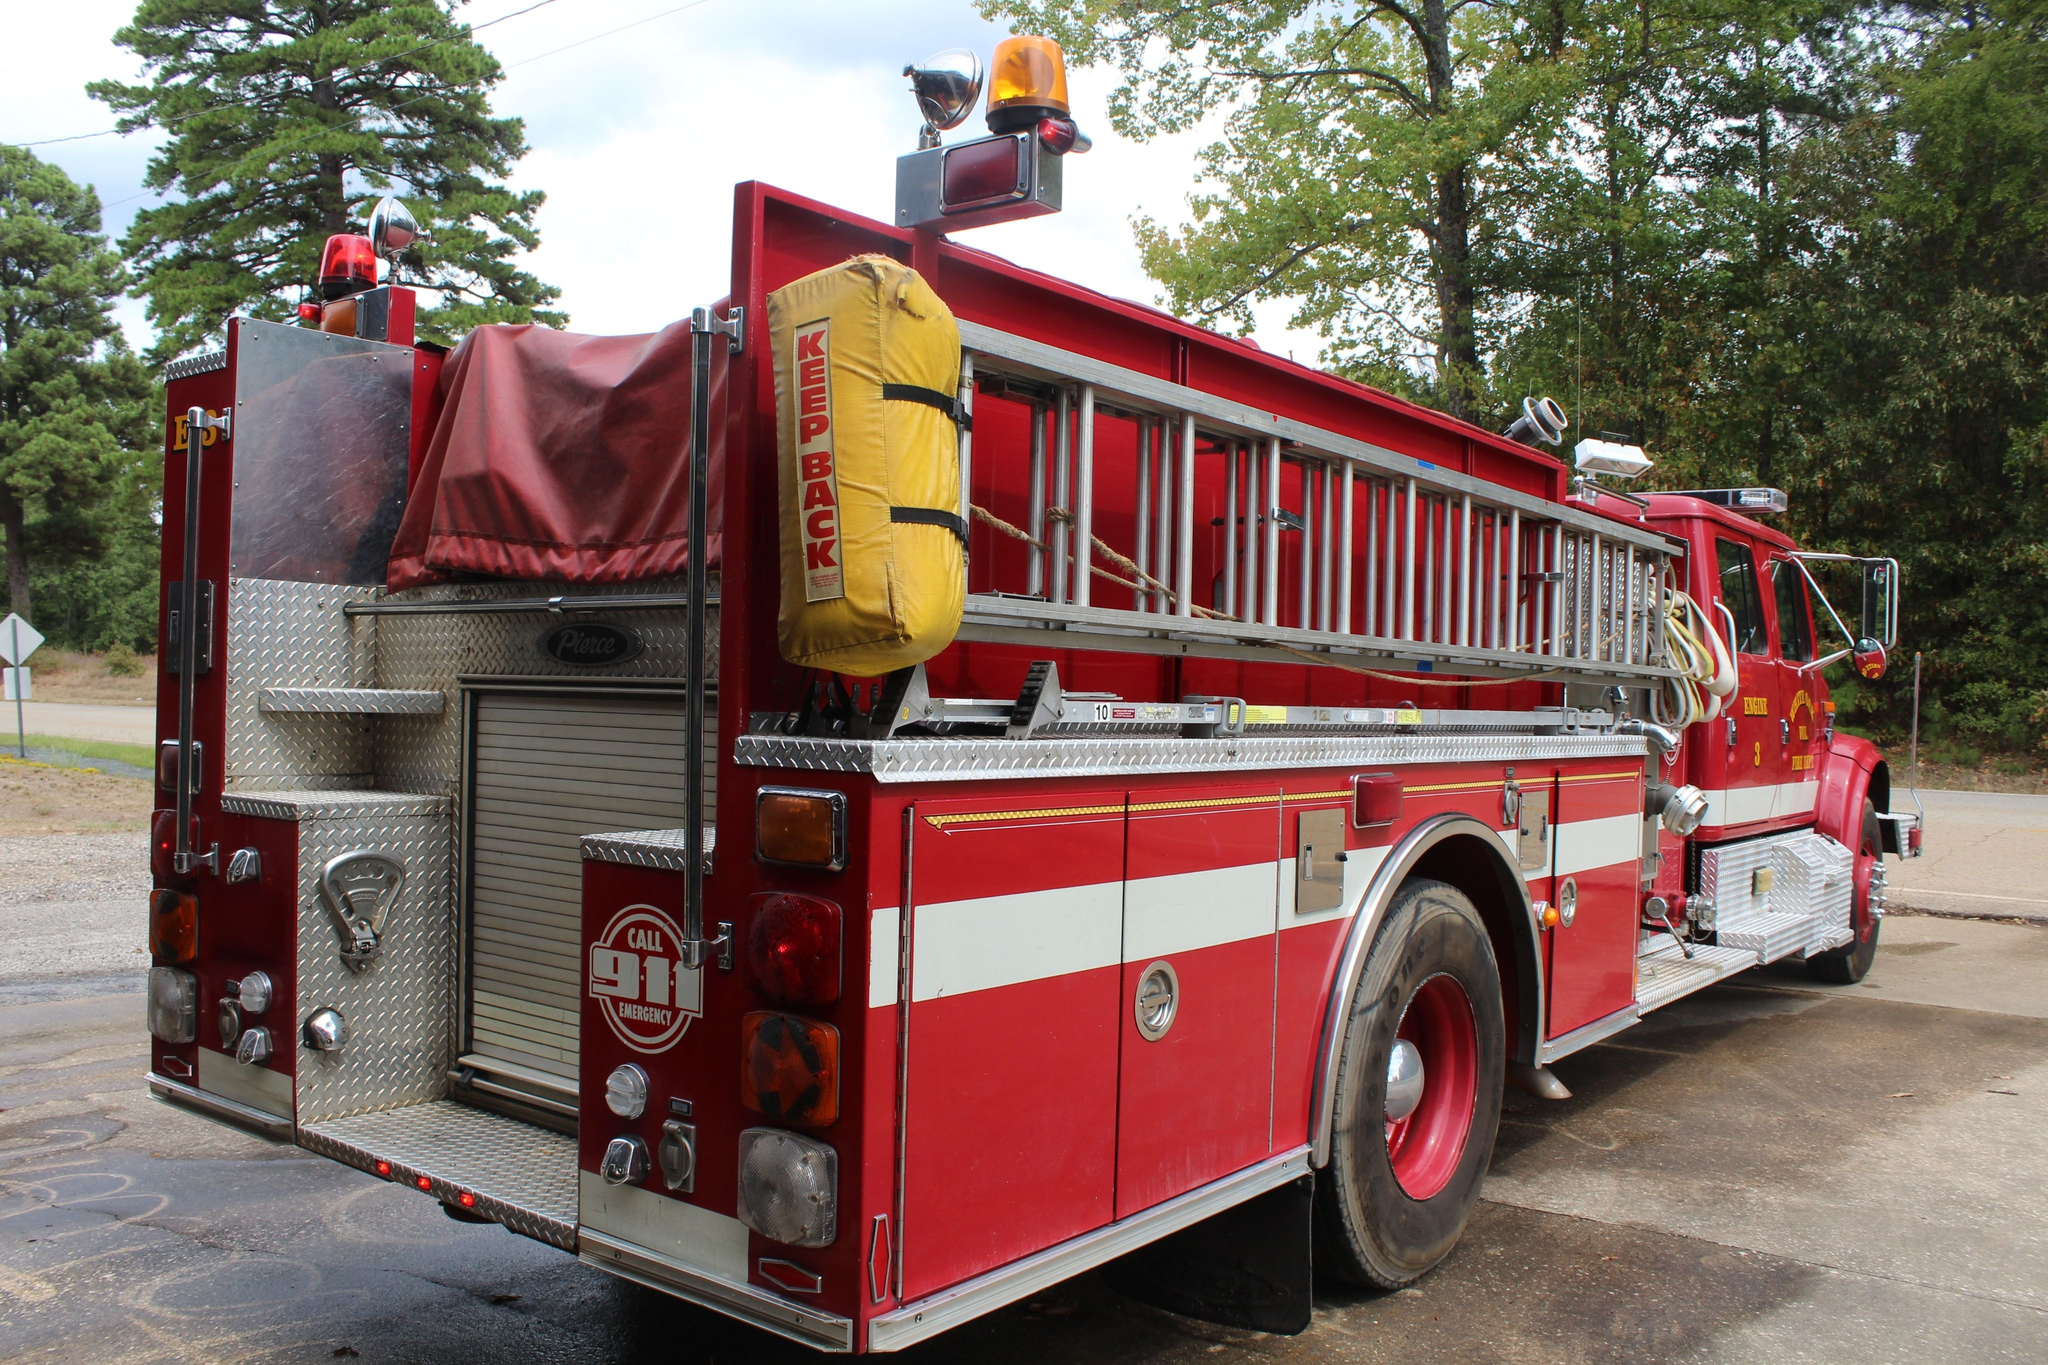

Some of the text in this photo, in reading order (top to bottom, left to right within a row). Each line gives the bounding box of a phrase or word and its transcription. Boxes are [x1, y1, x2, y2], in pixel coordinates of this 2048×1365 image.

[797, 329, 829, 445] KEEP
[802, 451, 838, 571] BACK
[556, 629, 616, 658] Pierce
[1096, 704, 1108, 721] 10
[1743, 697, 1768, 716] ENGINE
[1754, 741, 1761, 767] 3
[1791, 755, 1803, 771] FIRE
[627, 927, 663, 952] CALL
[618, 1002, 672, 1026] EMERGENCY
